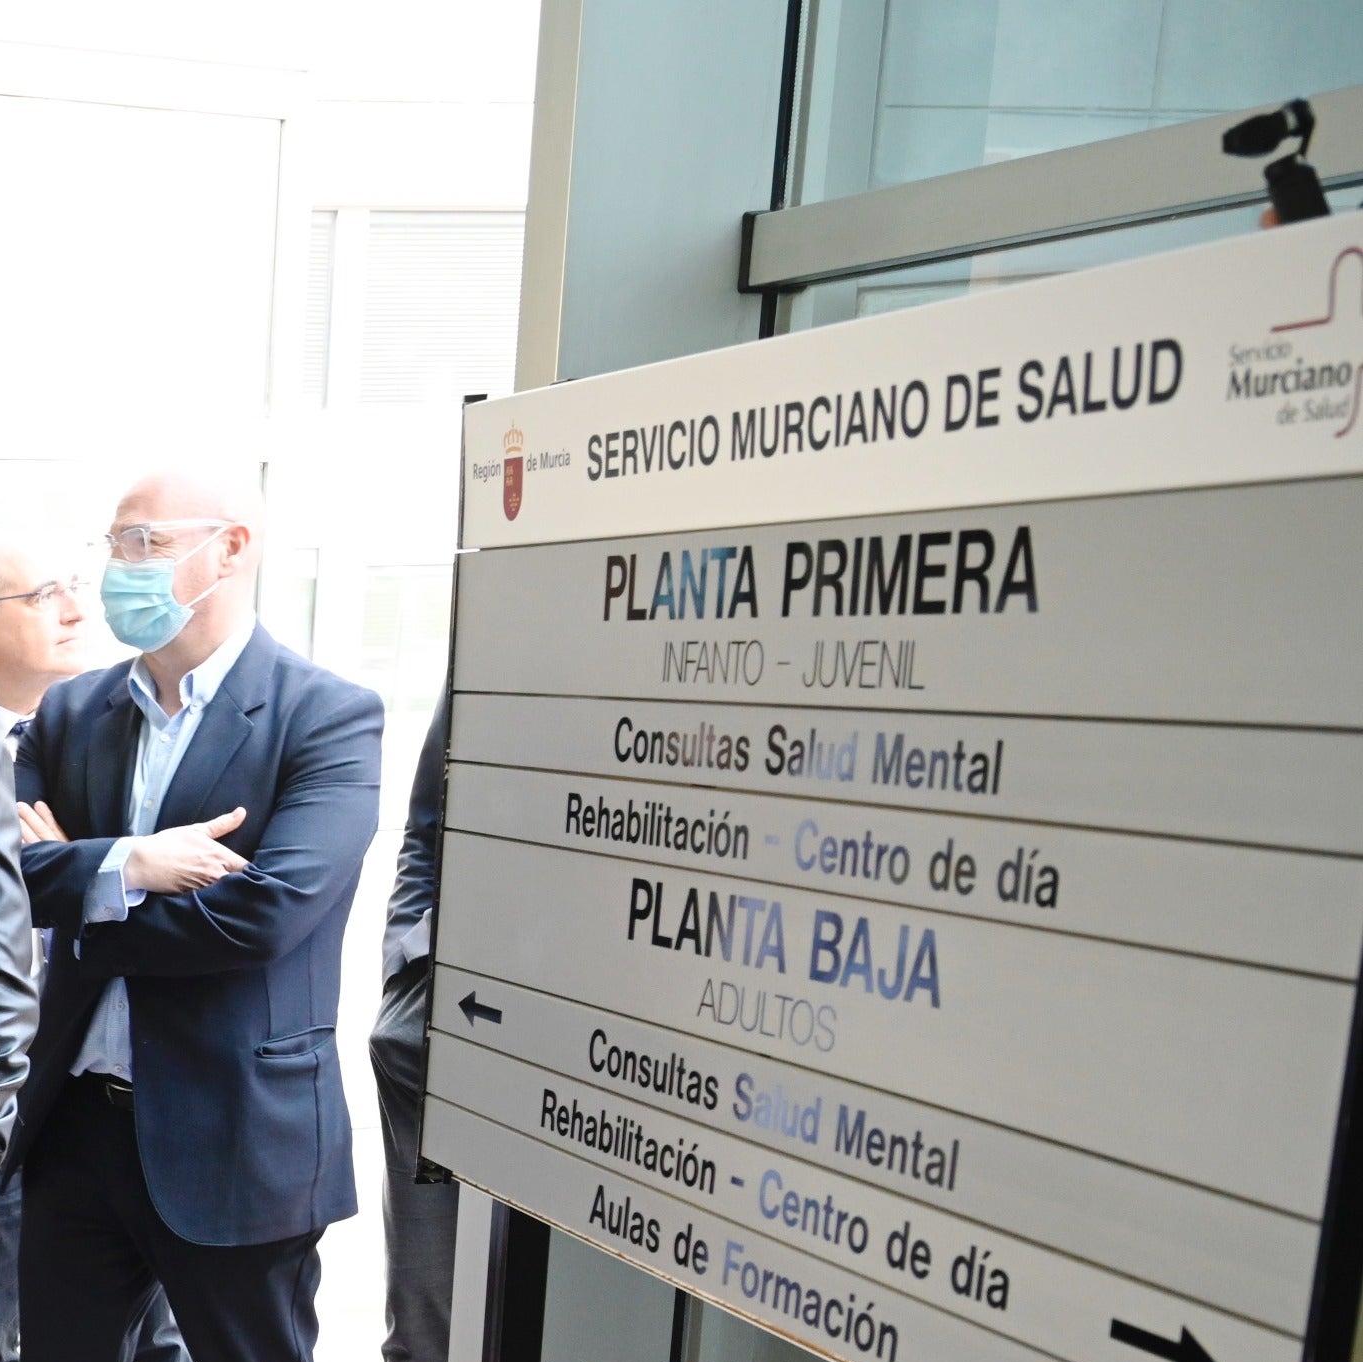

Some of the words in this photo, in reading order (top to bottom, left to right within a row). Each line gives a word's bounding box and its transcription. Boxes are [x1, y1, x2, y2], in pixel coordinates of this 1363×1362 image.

[587, 415, 720, 482] SERVICIO
[731, 379, 929, 461] MURCIANO
[944, 367, 1000, 432] DE
[1016, 338, 1184, 424] SALUD
[1225, 361, 1353, 401] Murciano
[1303, 394, 1351, 423] Salud
[473, 461, 501, 483] Región
[526, 453, 538, 472] de
[540, 448, 571, 470] Murcia
[603, 545, 759, 622] PLANTA
[782, 526, 1039, 616] PRIMERA
[662, 640, 765, 687] INFANTO
[803, 641, 925, 691] JUVENIL
[615, 717, 750, 772] Consultas
[765, 724, 856, 782] Salud
[873, 733, 1003, 795] Mental
[566, 792, 750, 861] Rehabilitación
[794, 819, 911, 886] Centro
[929, 838, 976, 893] de
[997, 849, 1061, 909] día
[628, 879, 785, 975] PLANTA
[809, 908, 942, 1008] BAJA
[697, 978, 836, 1053] ADULTOS
[589, 1029, 719, 1111] Consultas
[732, 1073, 822, 1145] Salud
[836, 1105, 960, 1192] Mental
[541, 1089, 717, 1195] Rehabilitación
[759, 1170, 870, 1256] Centro
[886, 1222, 932, 1278] de
[950, 1249, 1012, 1312] día
[589, 1187, 661, 1253] Aulas
[674, 1222, 710, 1275] de
